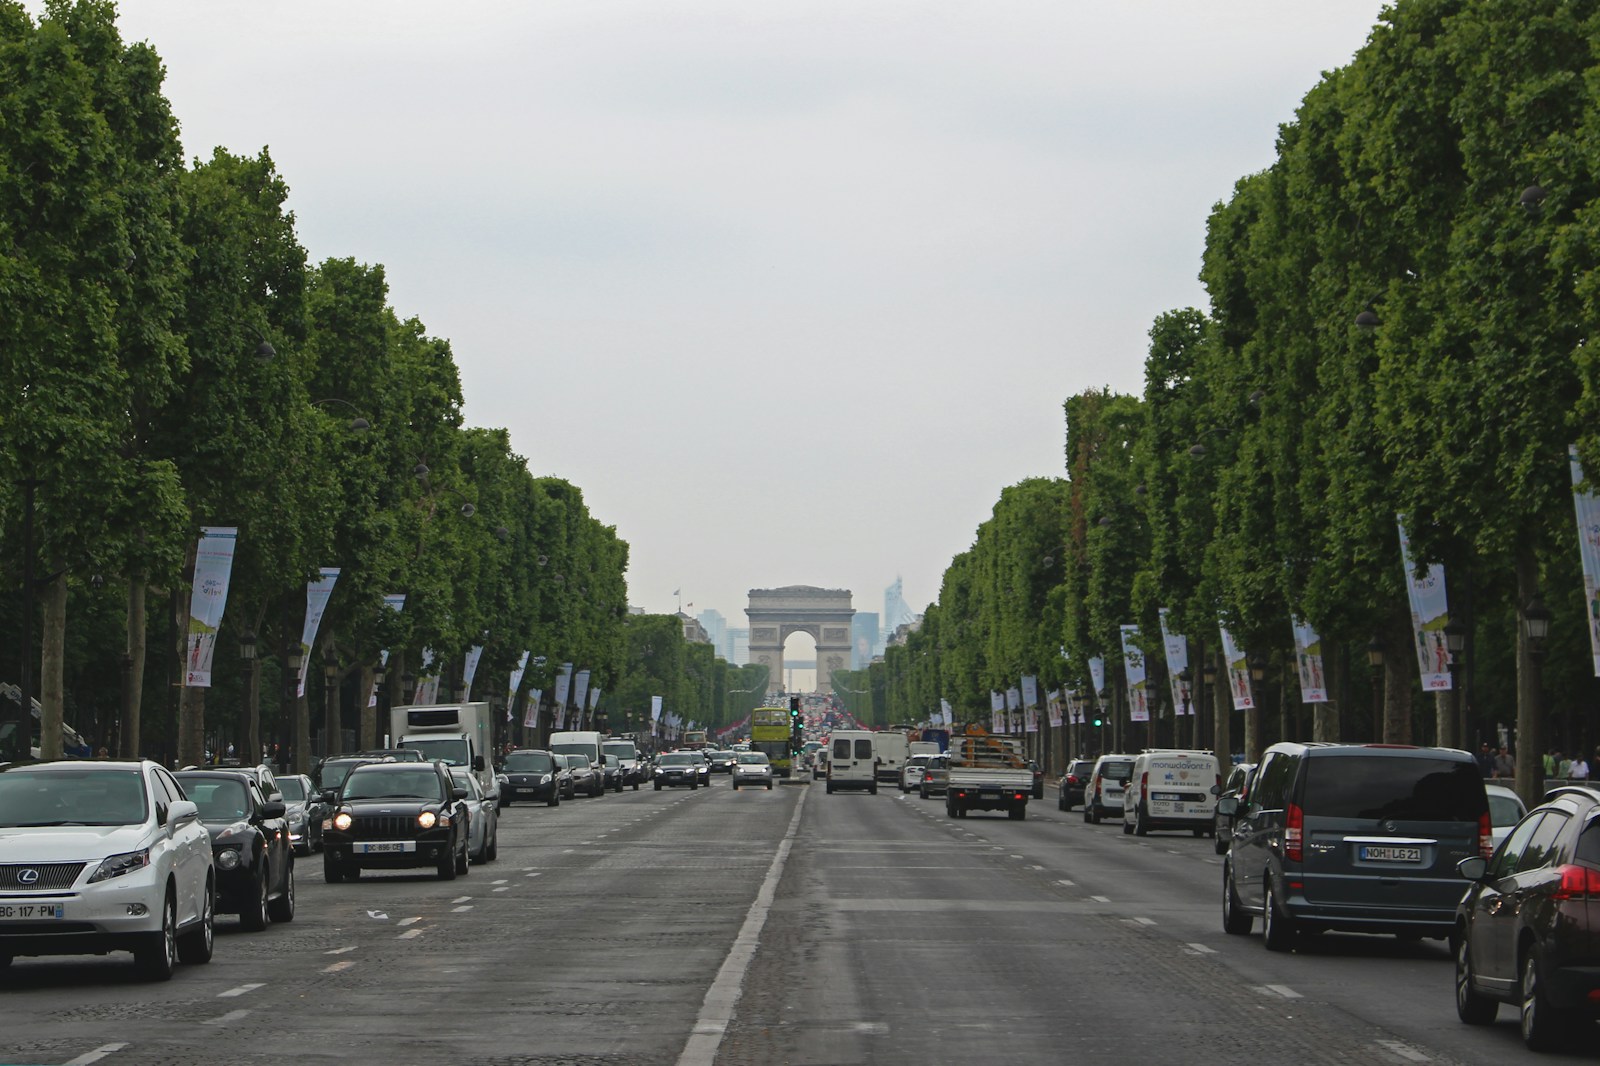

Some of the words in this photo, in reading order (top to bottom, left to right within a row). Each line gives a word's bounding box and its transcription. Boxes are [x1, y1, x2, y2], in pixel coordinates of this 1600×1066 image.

[1366, 848, 1386, 858] NOH
[1392, 849, 1406, 859] LG
[1407, 849, 1420, 860] 21
